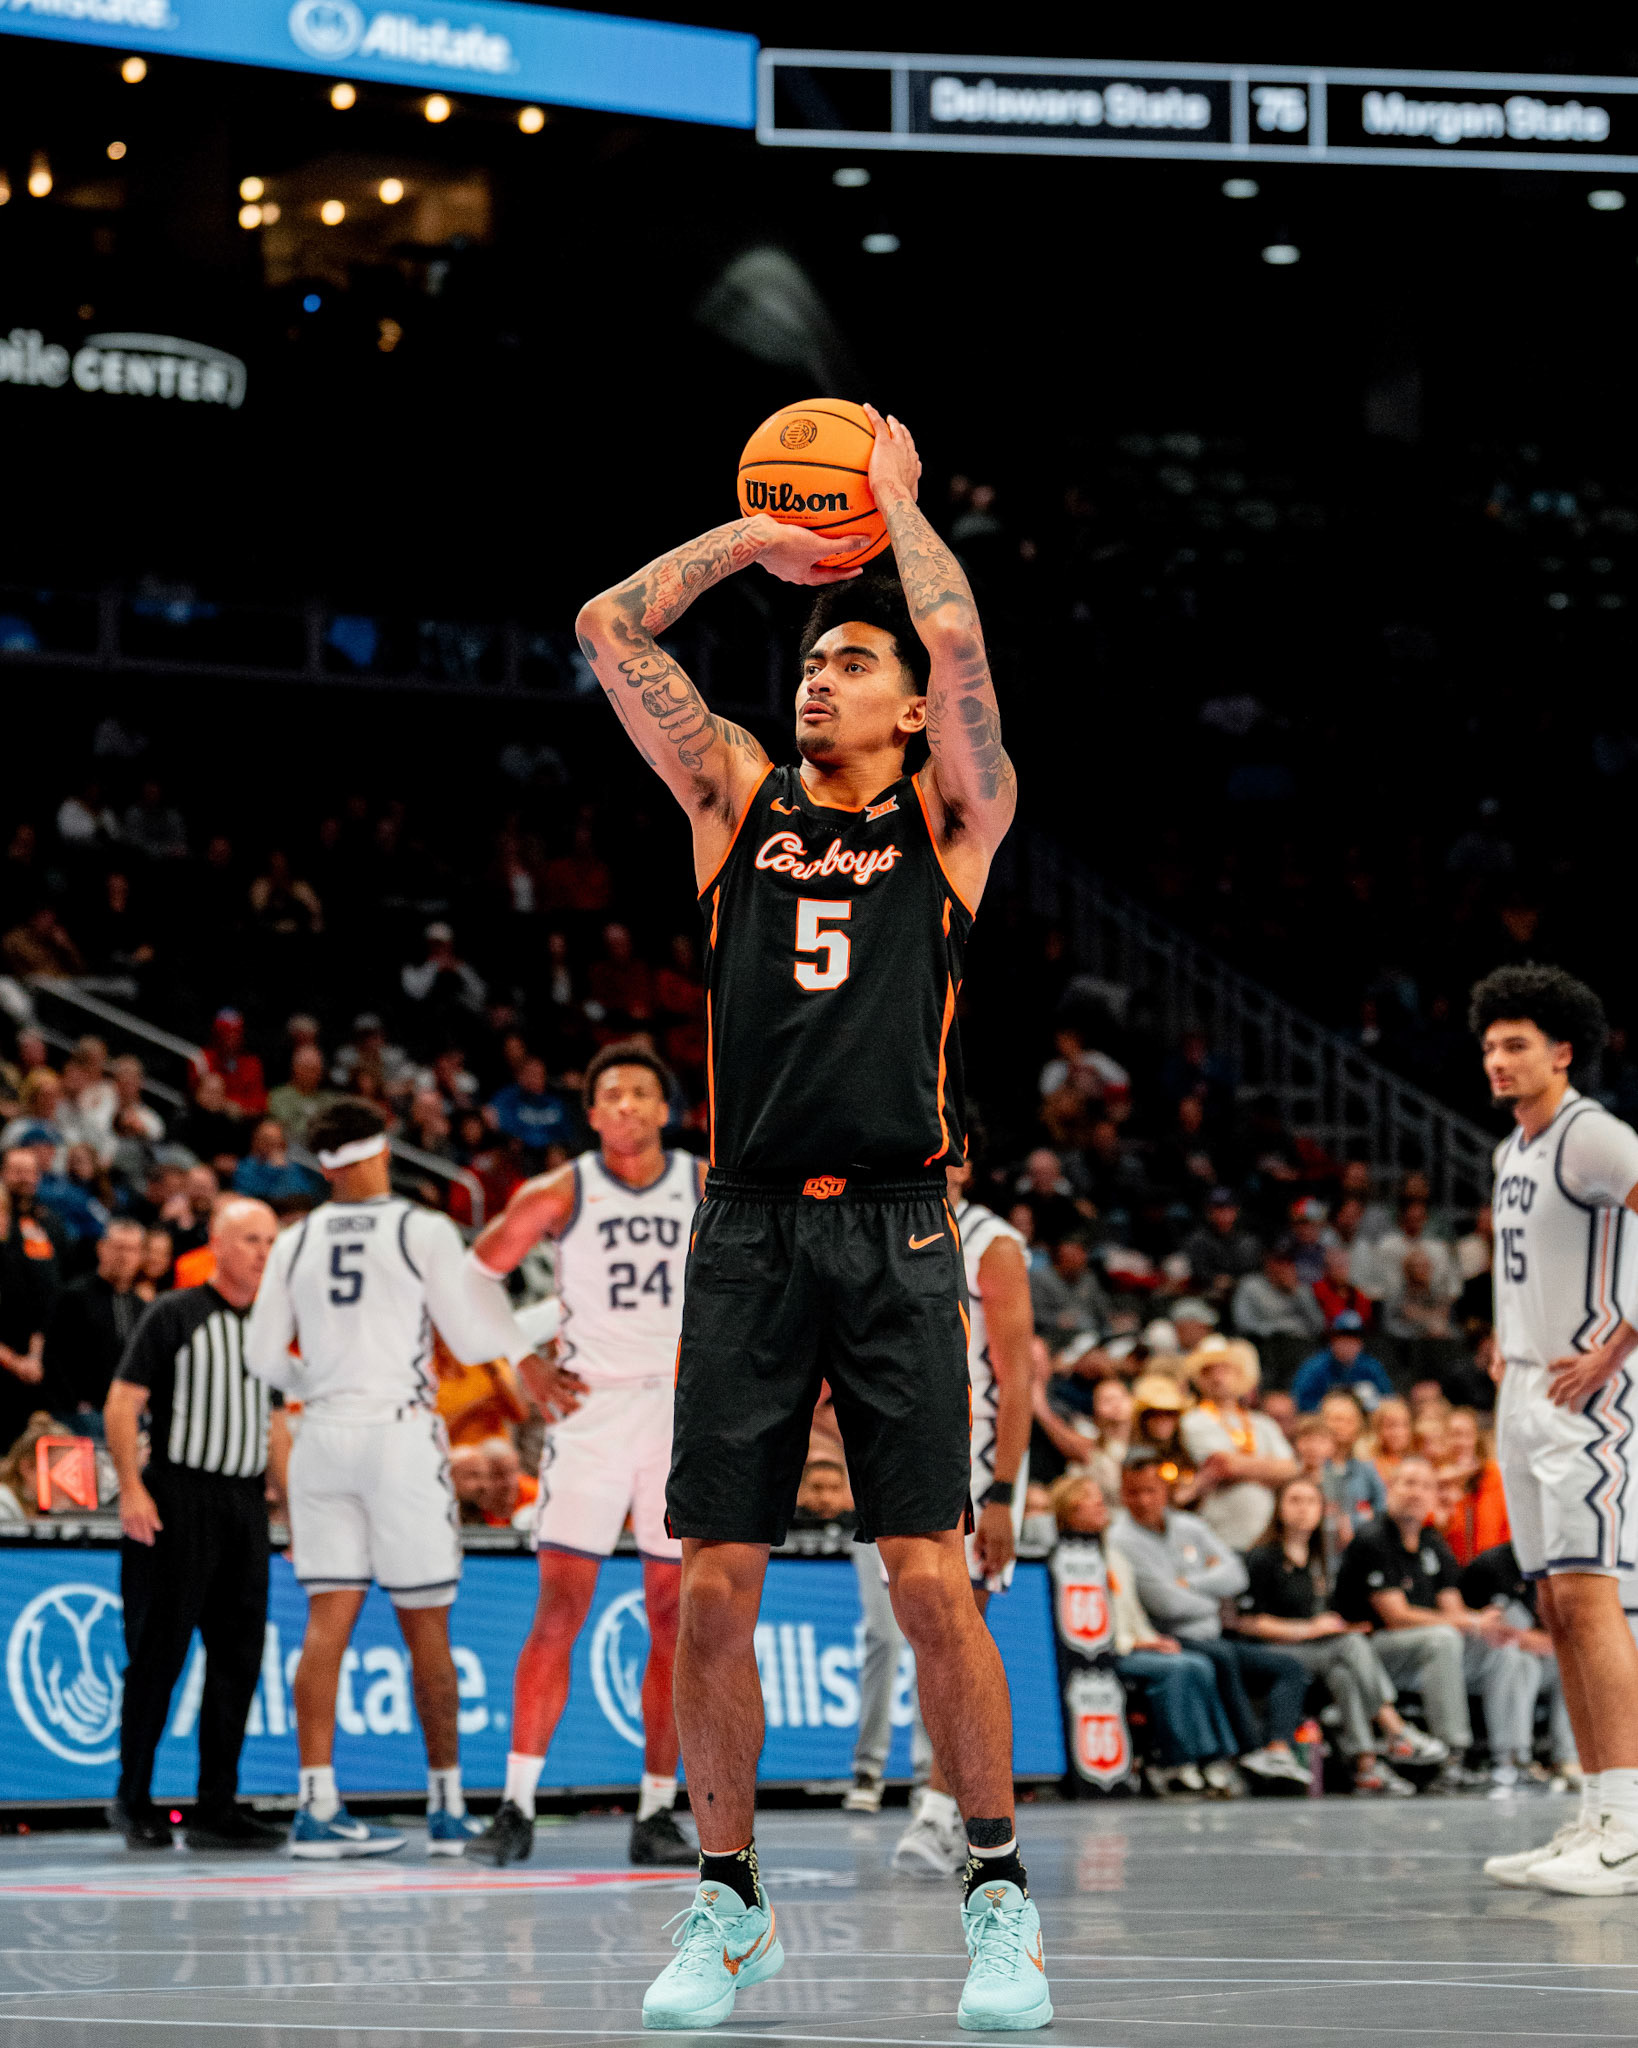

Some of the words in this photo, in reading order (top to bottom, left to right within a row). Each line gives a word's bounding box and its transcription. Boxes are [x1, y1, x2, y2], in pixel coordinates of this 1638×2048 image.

[360, 12, 512, 73] Allstate
[931, 77, 1102, 126] Delaware
[1103, 83, 1211, 130] State
[1250, 86, 1306, 132] 75
[1362, 91, 1504, 144] Morgan
[1505, 96, 1610, 142] State
[72, 346, 231, 405] CENTER
[745, 478, 849, 512] Wilson
[755, 831, 902, 885] Cowboys
[794, 897, 852, 991] 5
[802, 1175, 847, 1199] OSU
[1499, 1175, 1537, 1214] TCU
[598, 1216, 681, 1250] TCU
[1502, 1227, 1527, 1283] 15
[330, 1243, 364, 1306] 5
[608, 1260, 672, 1308] 24
